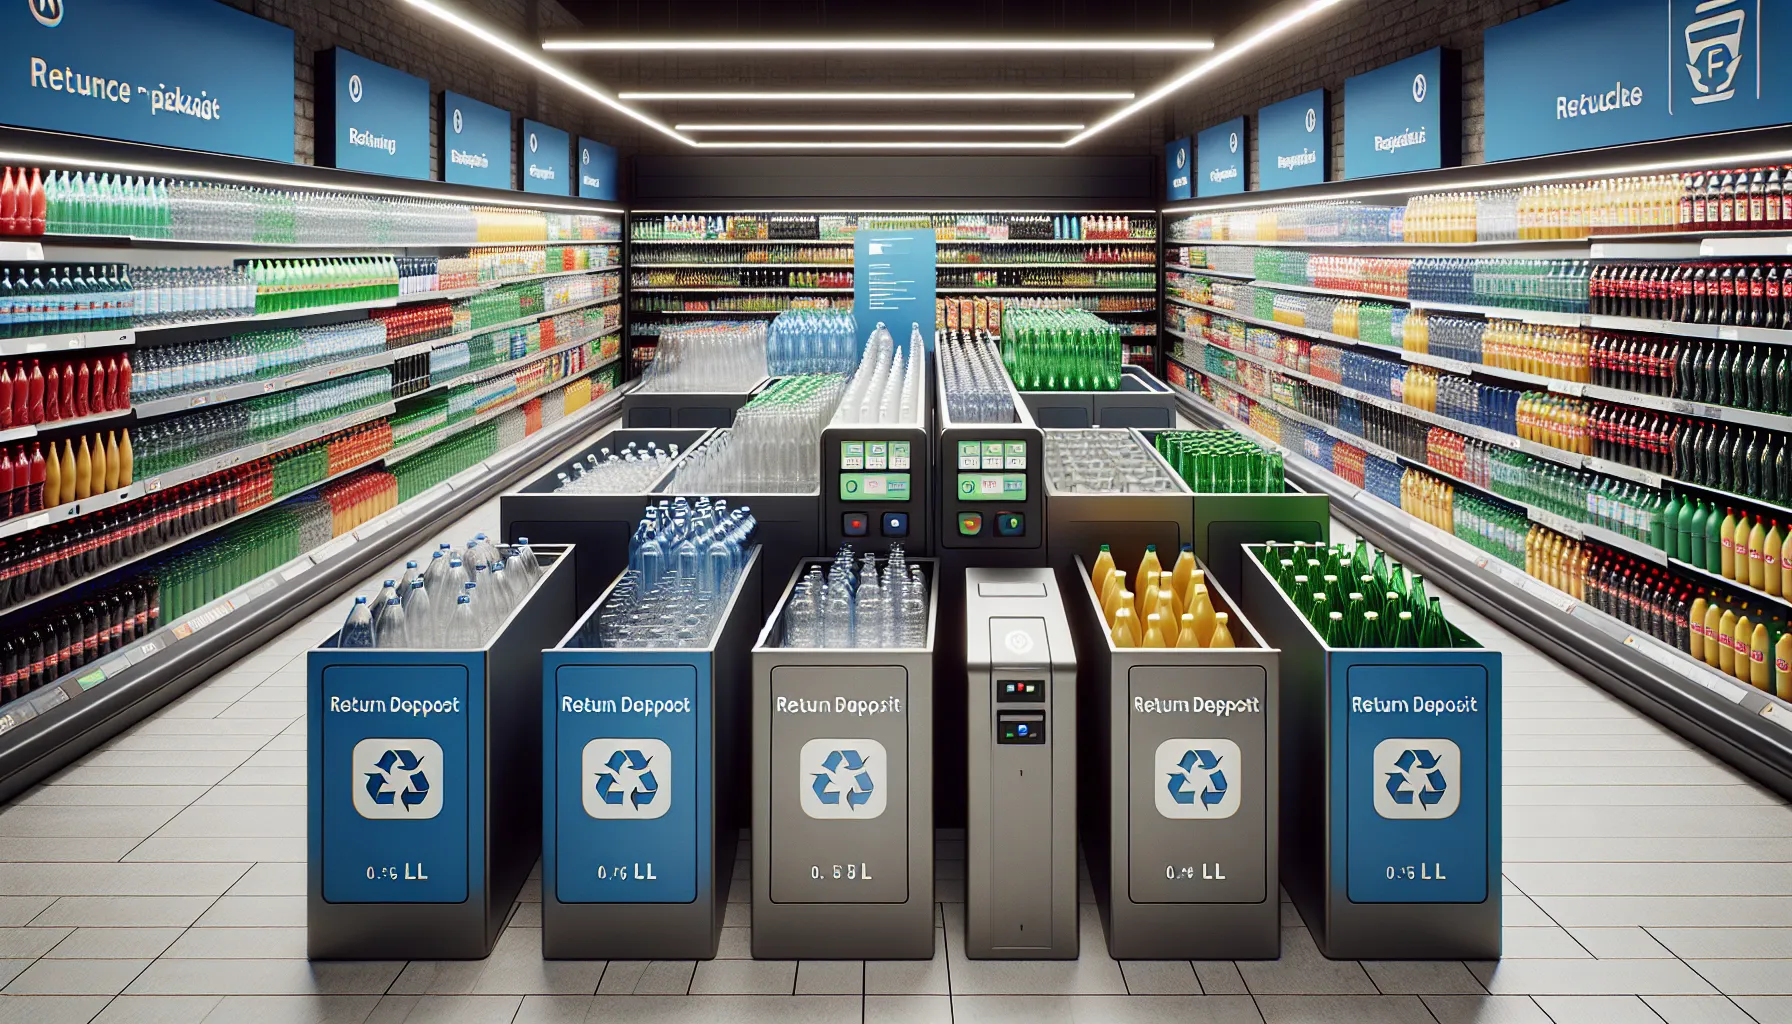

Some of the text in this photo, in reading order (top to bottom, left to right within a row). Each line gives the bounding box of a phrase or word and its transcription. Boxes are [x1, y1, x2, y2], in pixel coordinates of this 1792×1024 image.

[404, 862, 429, 880] LL
[634, 862, 657, 880] LL
[1202, 862, 1226, 880] LL
[1421, 862, 1446, 880] LL
